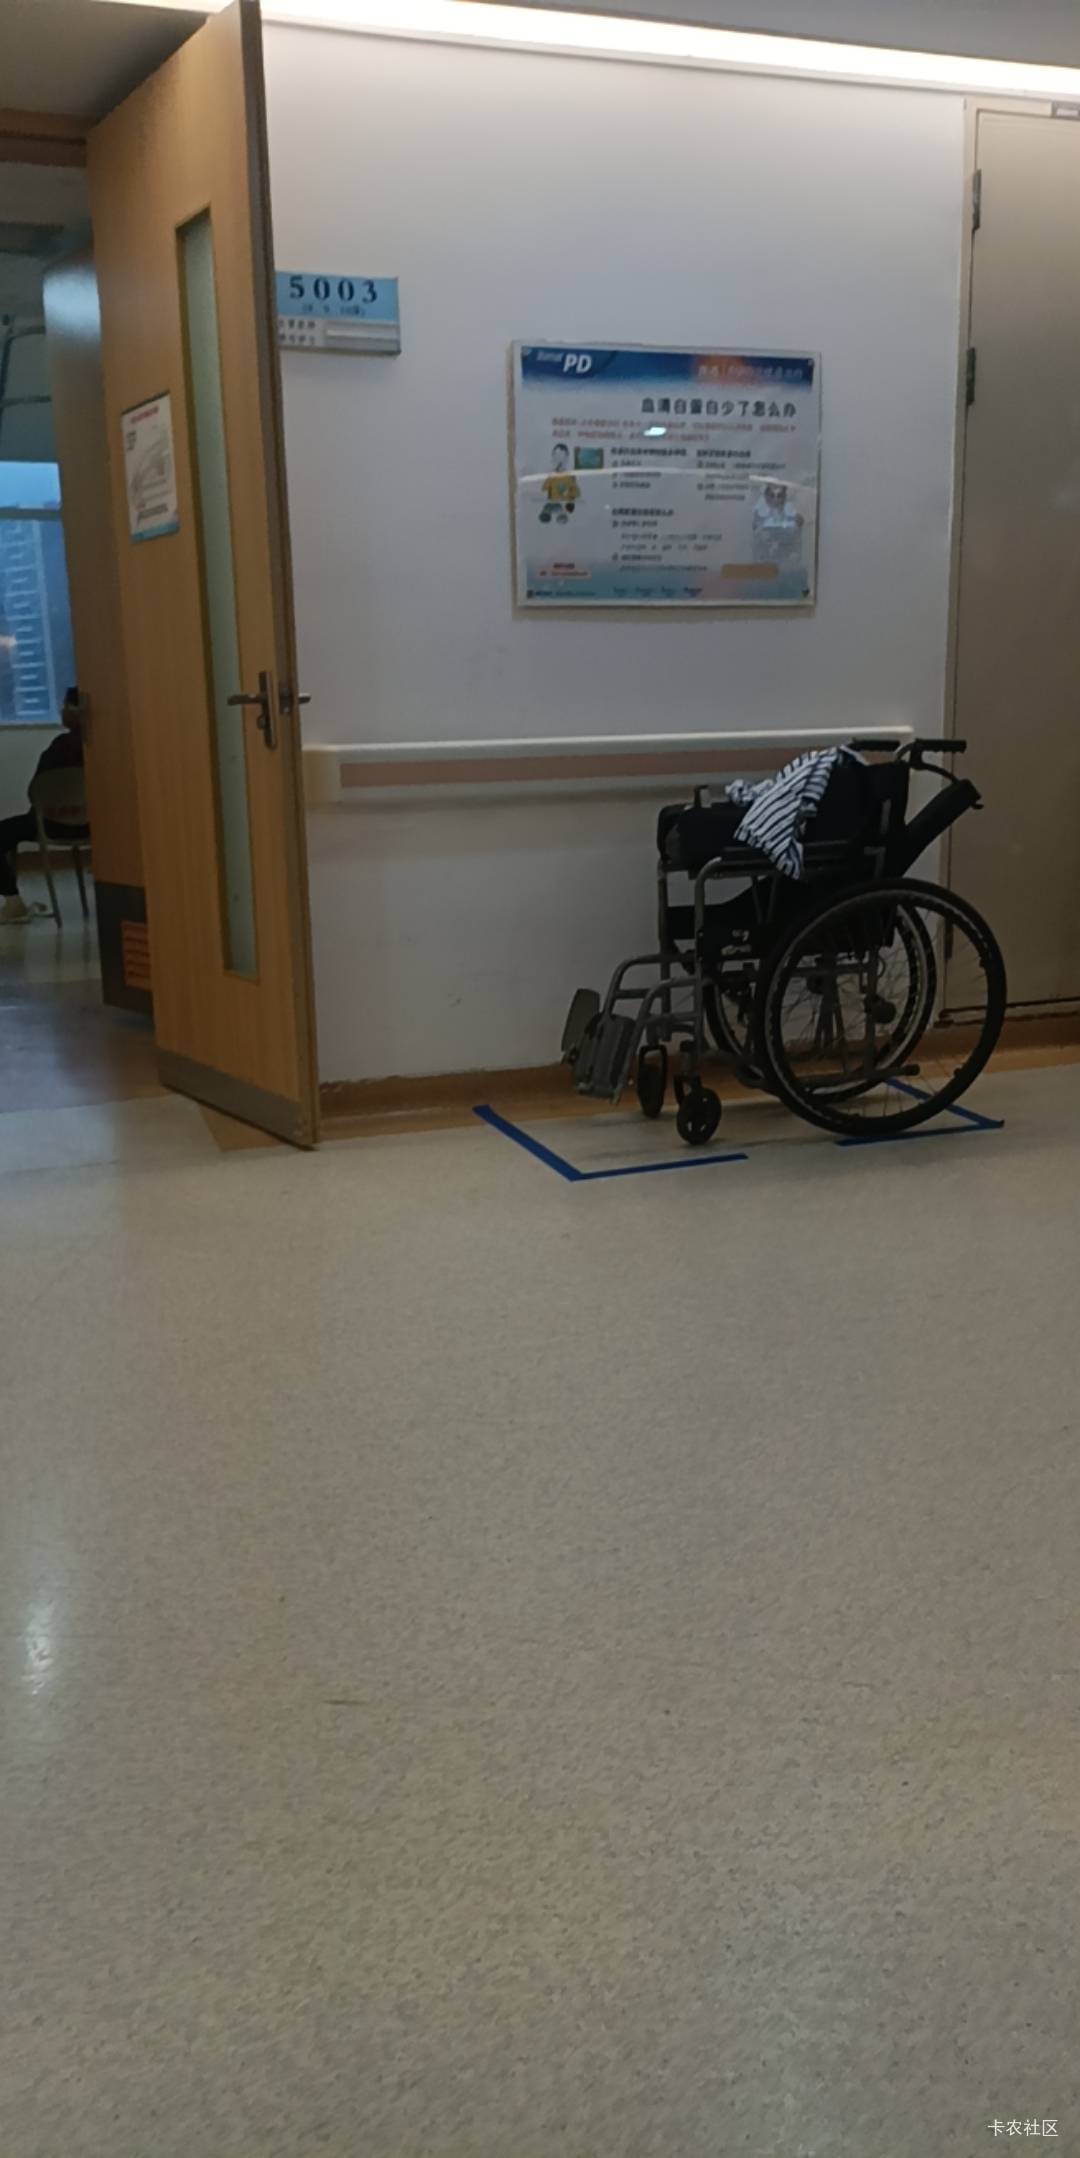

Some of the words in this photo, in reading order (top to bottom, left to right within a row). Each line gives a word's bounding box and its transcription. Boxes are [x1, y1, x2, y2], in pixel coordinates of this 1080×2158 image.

[289, 275, 378, 304] 5003
[563, 353, 592, 374] PD
[641, 397, 797, 418] 血清白蛋白少了怎么办
